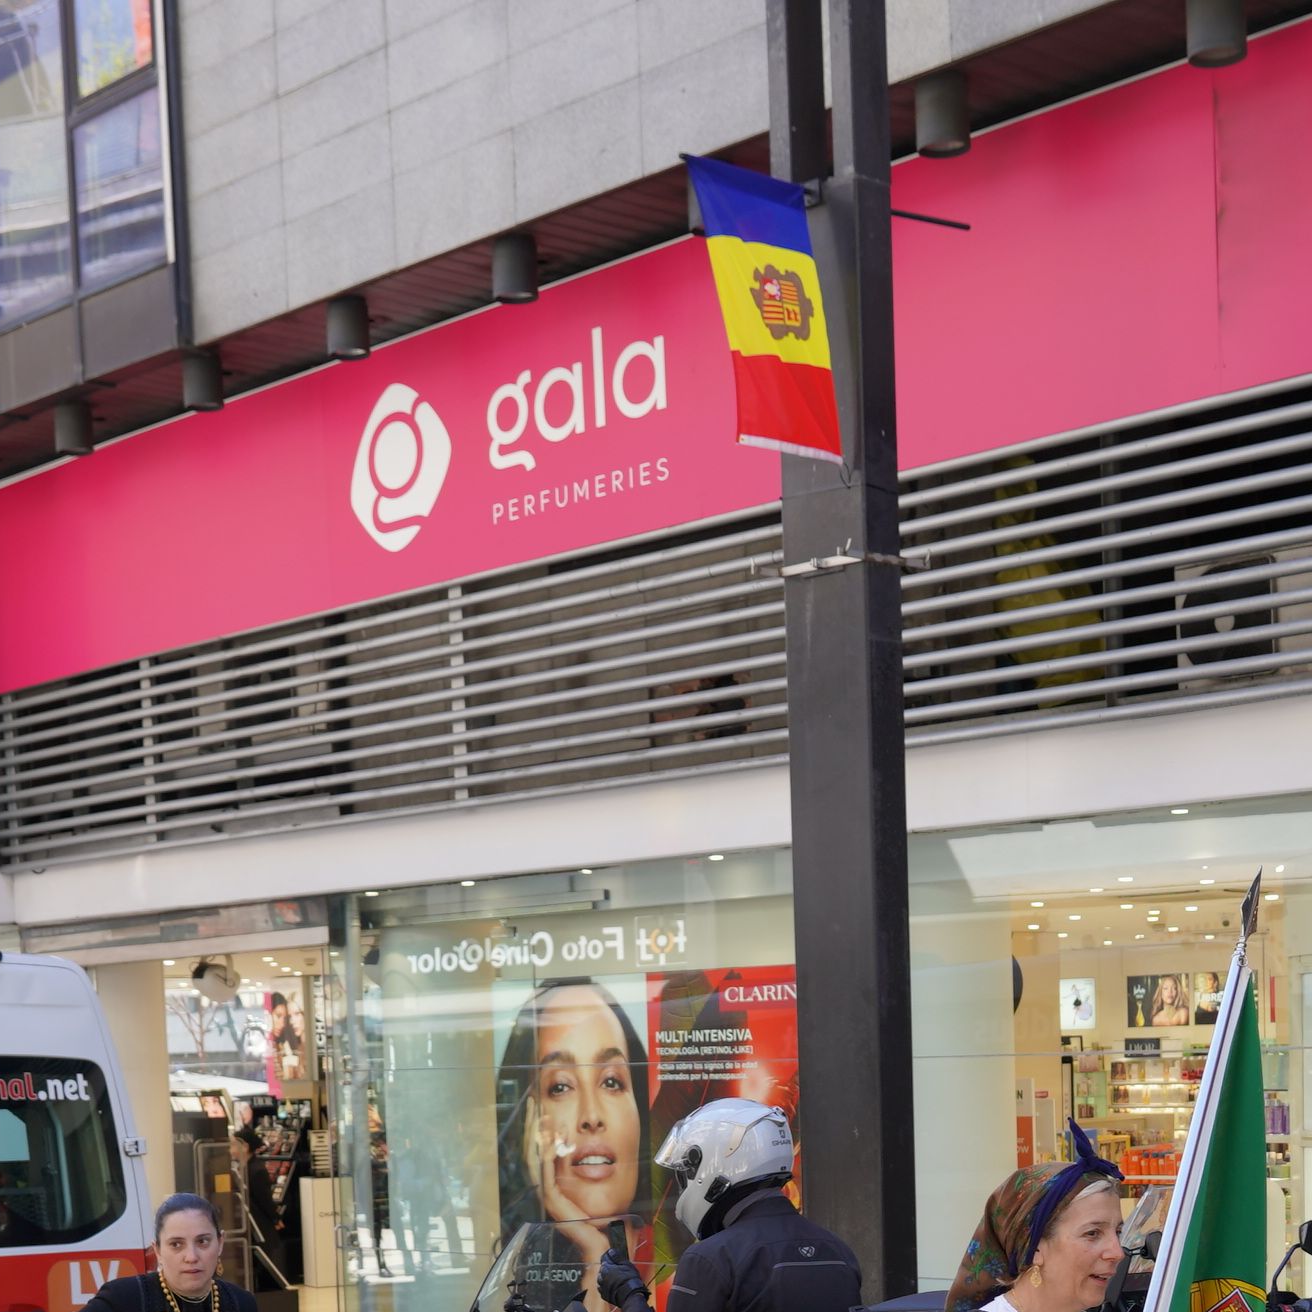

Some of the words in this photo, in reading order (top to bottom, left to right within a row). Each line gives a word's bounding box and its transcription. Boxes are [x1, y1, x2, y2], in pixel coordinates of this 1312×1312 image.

[486, 326, 669, 472] gala
[492, 458, 671, 526] PERFUMERIES
[655, 1028, 753, 1043] MULTI-INTENSIVA
